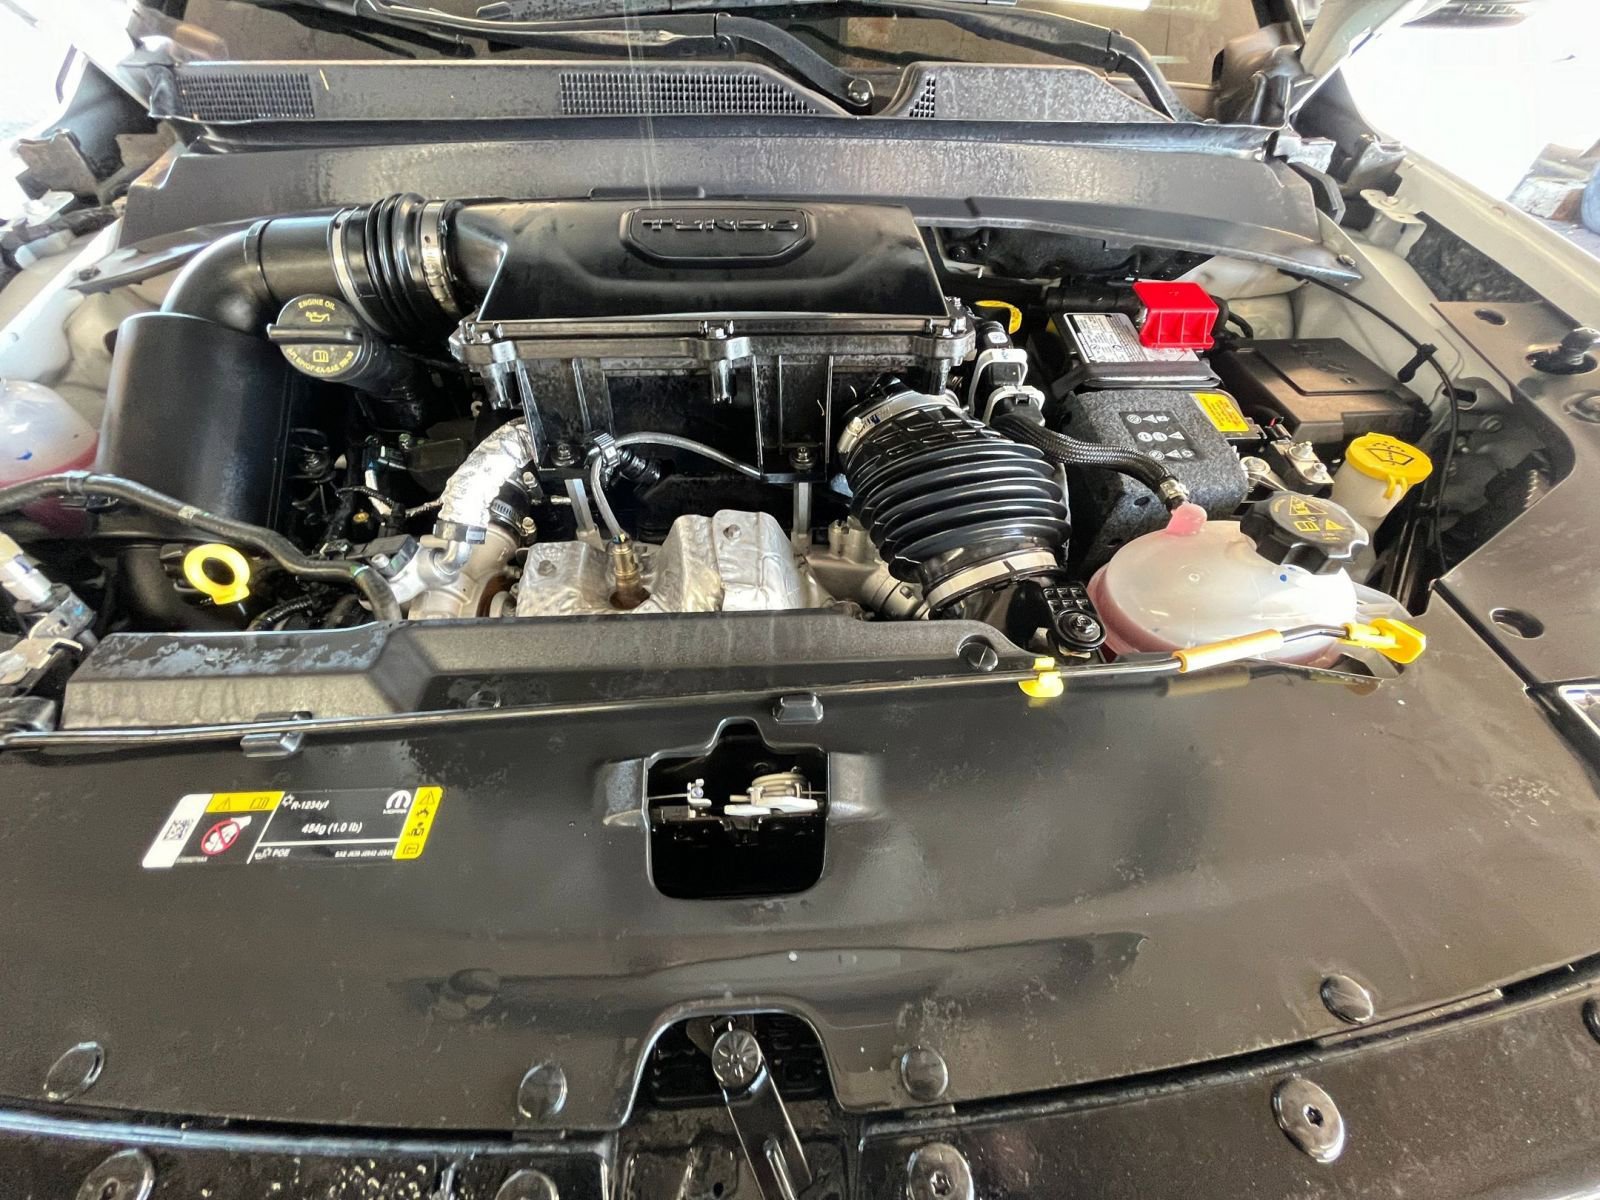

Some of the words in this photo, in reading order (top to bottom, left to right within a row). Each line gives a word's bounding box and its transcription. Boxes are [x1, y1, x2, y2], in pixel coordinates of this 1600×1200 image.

[298, 298, 324, 310] ENGINE
[324, 301, 336, 311] OIL
[290, 800, 330, 811] R-1234yf
[301, 823, 327, 836] 454g
[327, 822, 348, 835] (1.0
[348, 821, 363, 834] lb)
[272, 848, 291, 857] POE
